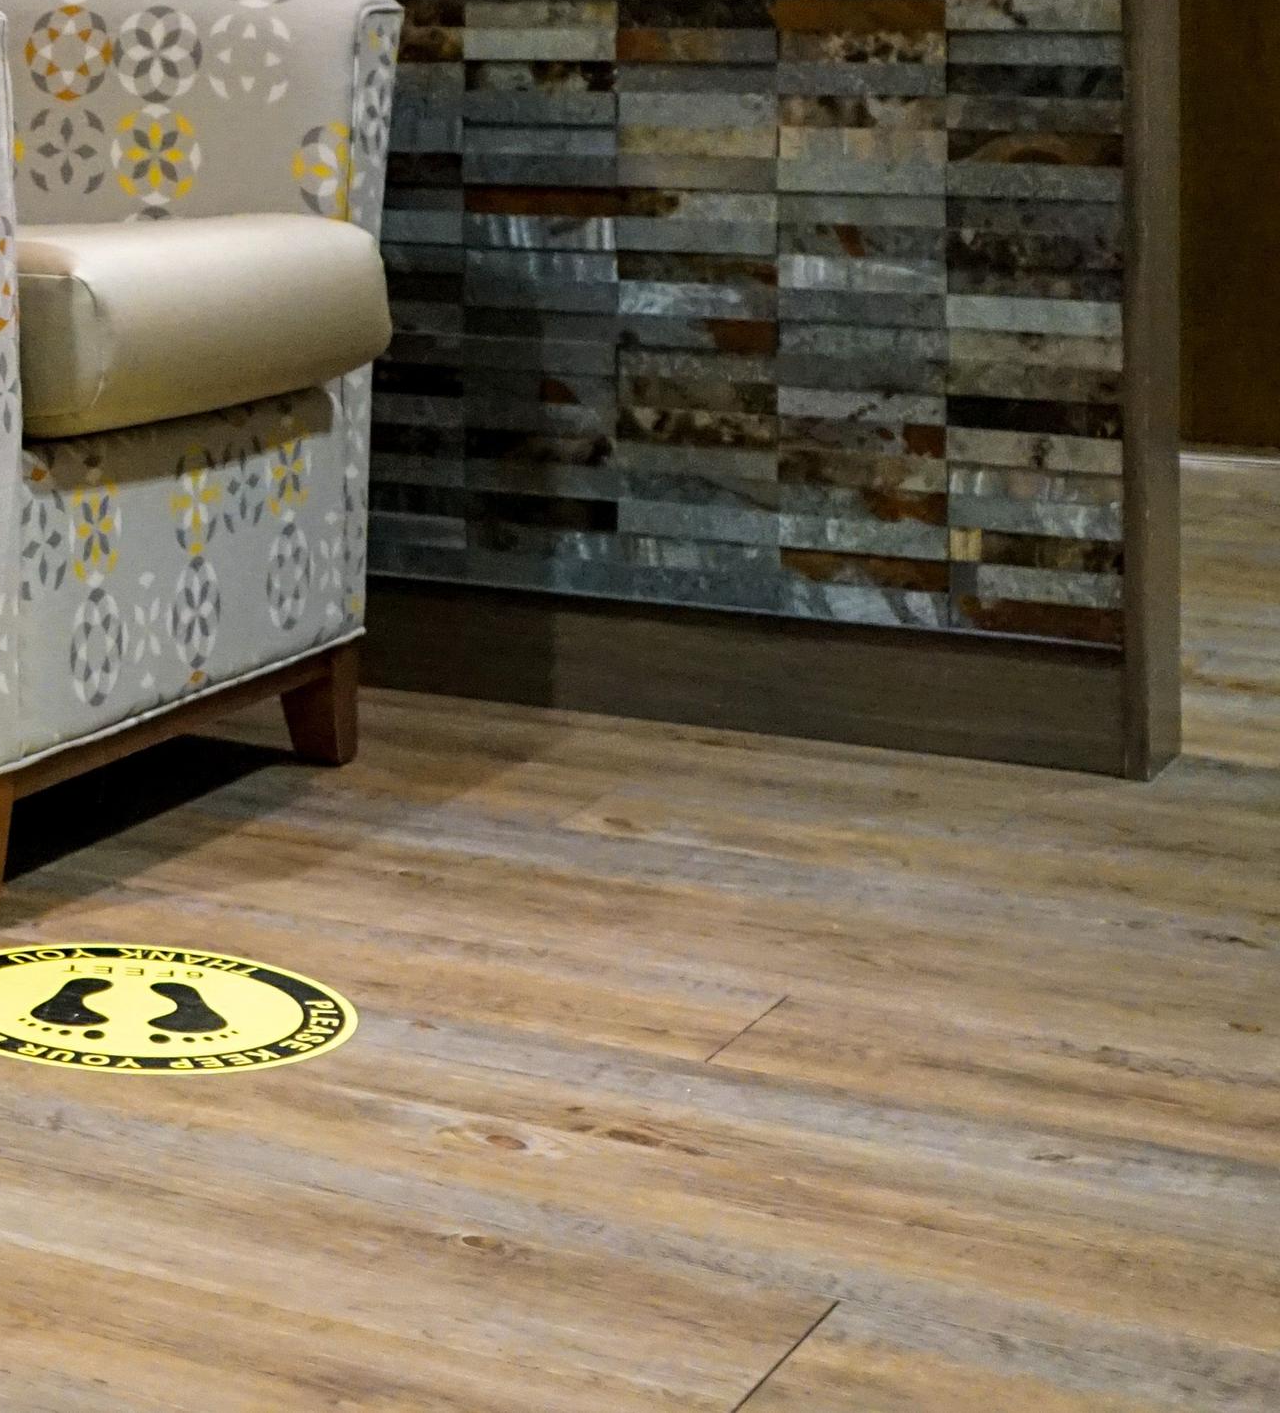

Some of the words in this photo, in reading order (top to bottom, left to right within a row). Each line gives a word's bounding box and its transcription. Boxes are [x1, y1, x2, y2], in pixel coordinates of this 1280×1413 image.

[7, 948, 98, 965] YOU
[118, 948, 259, 978] THANK
[278, 999, 341, 1053] PLEASE
[17, 1043, 144, 1070] YOUR
[169, 1048, 282, 1070] KEEP
